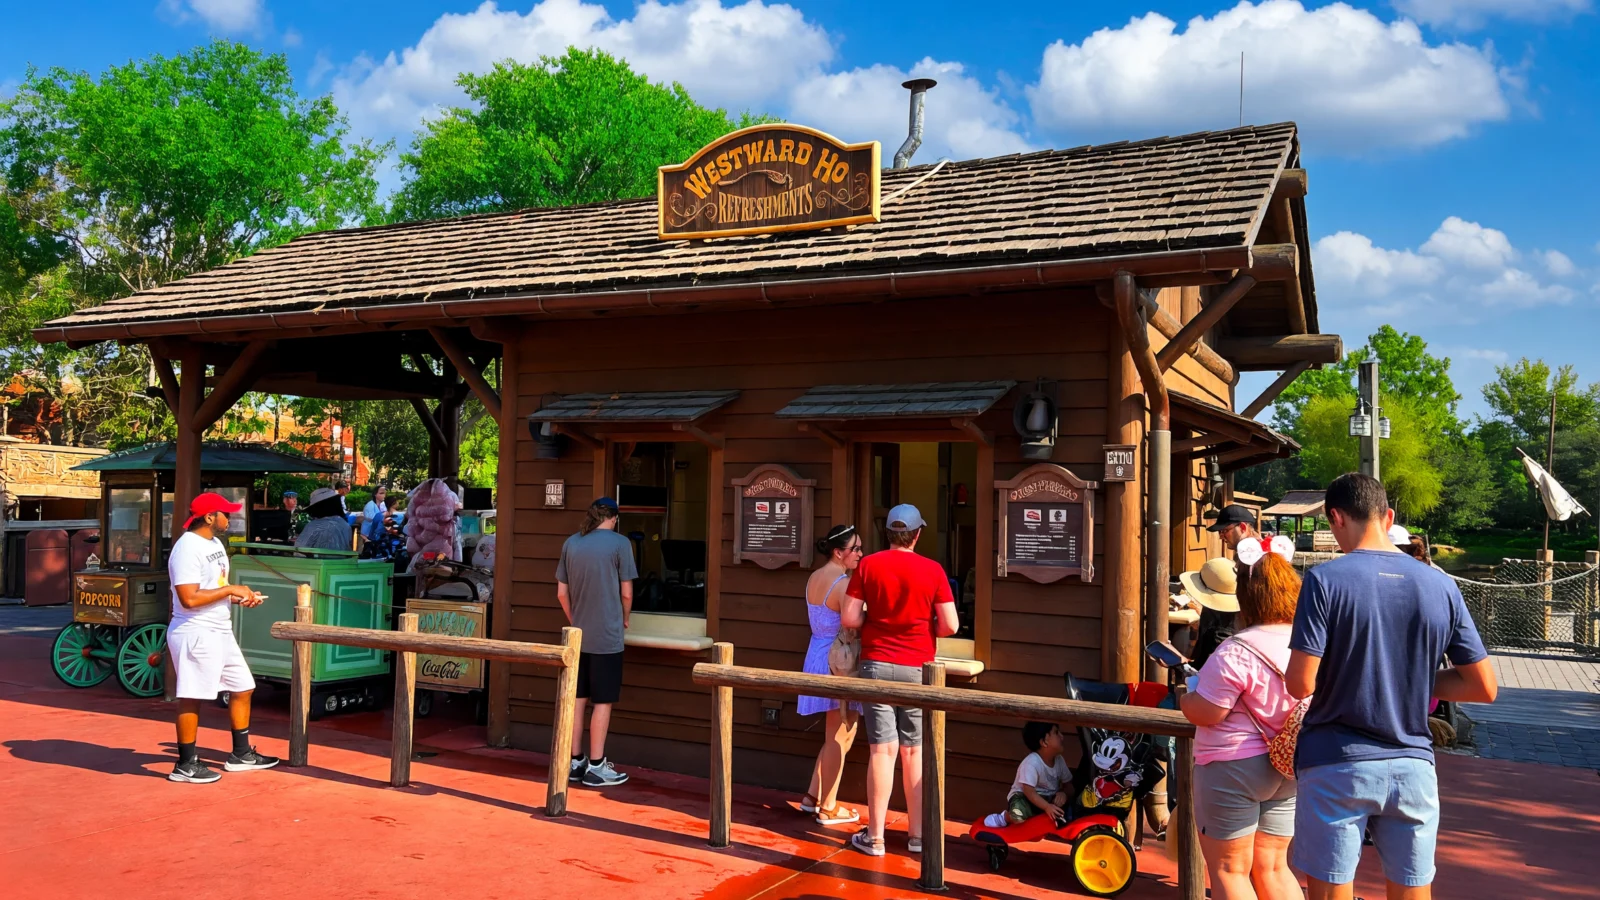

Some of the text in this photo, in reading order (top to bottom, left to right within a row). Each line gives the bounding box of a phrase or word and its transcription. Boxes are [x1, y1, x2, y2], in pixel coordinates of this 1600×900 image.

[684, 139, 850, 199] WESTWARD HO
[717, 182, 813, 224] REFRESHMENTS
[79, 591, 122, 608] POPCORN
